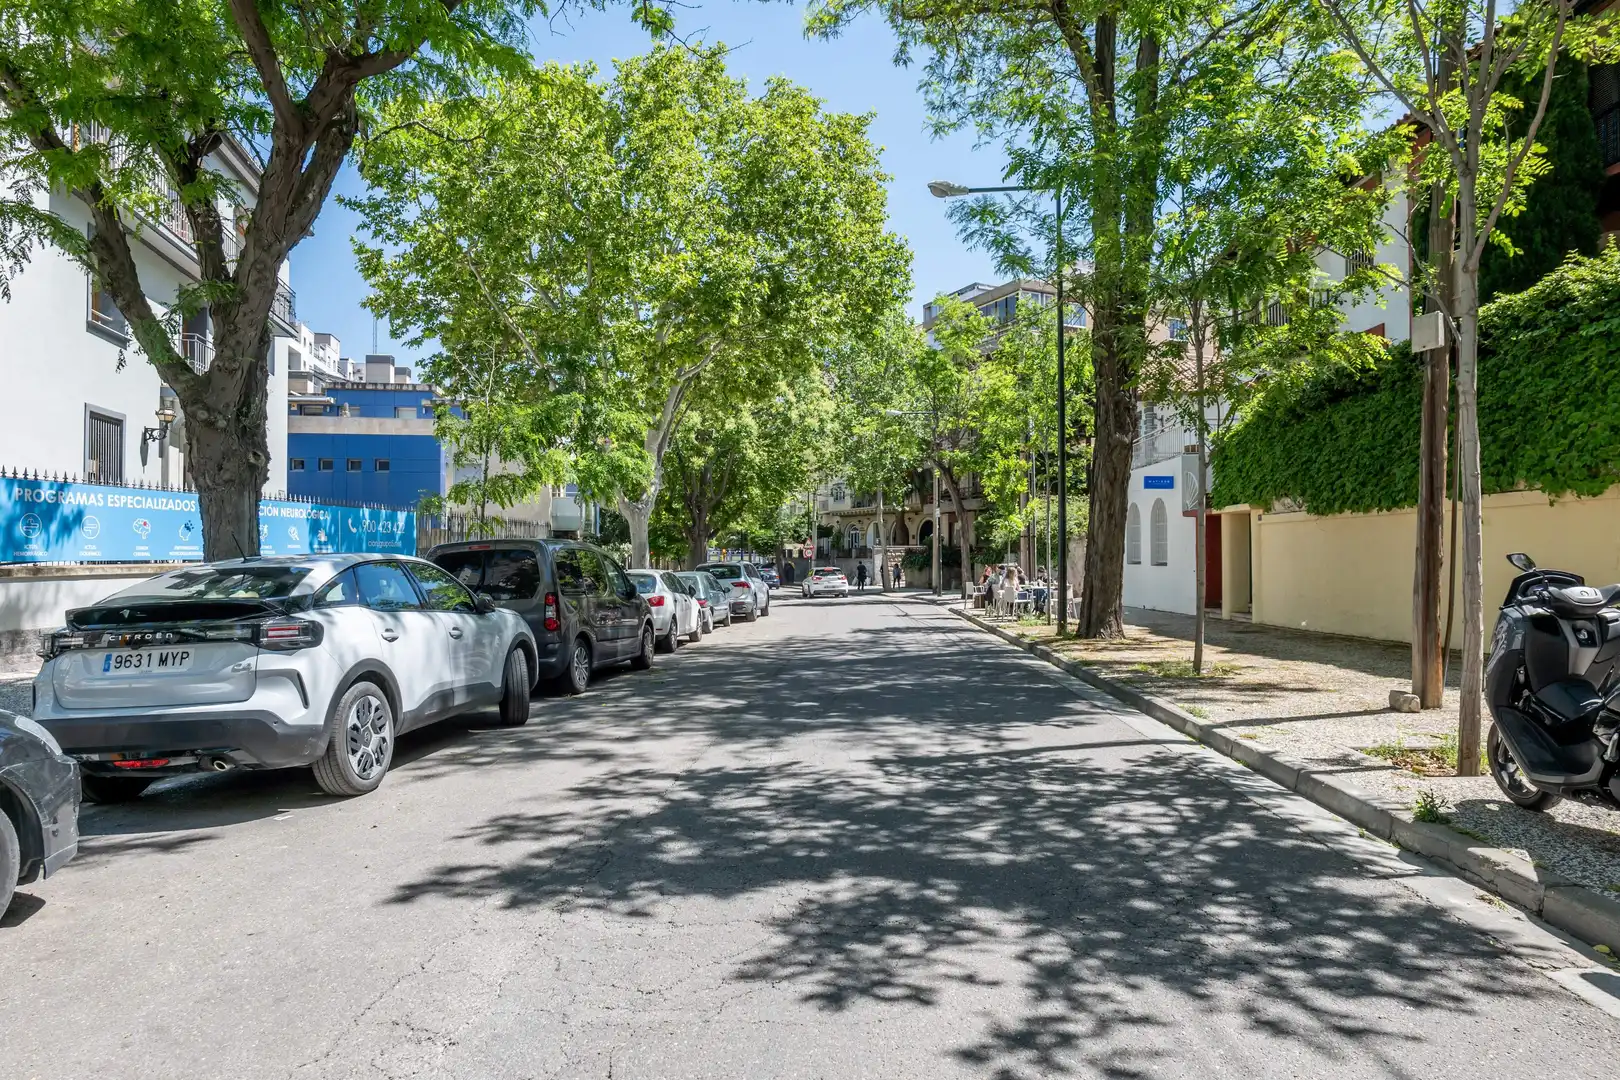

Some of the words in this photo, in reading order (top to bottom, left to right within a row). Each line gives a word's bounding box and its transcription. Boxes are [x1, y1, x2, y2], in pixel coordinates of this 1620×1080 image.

[15, 487, 104, 507] PROGRAMAS
[107, 494, 196, 512] ESPECIALIZADOS
[280, 506, 329, 520] NEUROLÓGICA
[362, 519, 376, 533] 900
[377, 520, 391, 533] 423
[392, 522, 405, 534] 422
[114, 653, 152, 670] 9631
[158, 651, 190, 667] MYP
